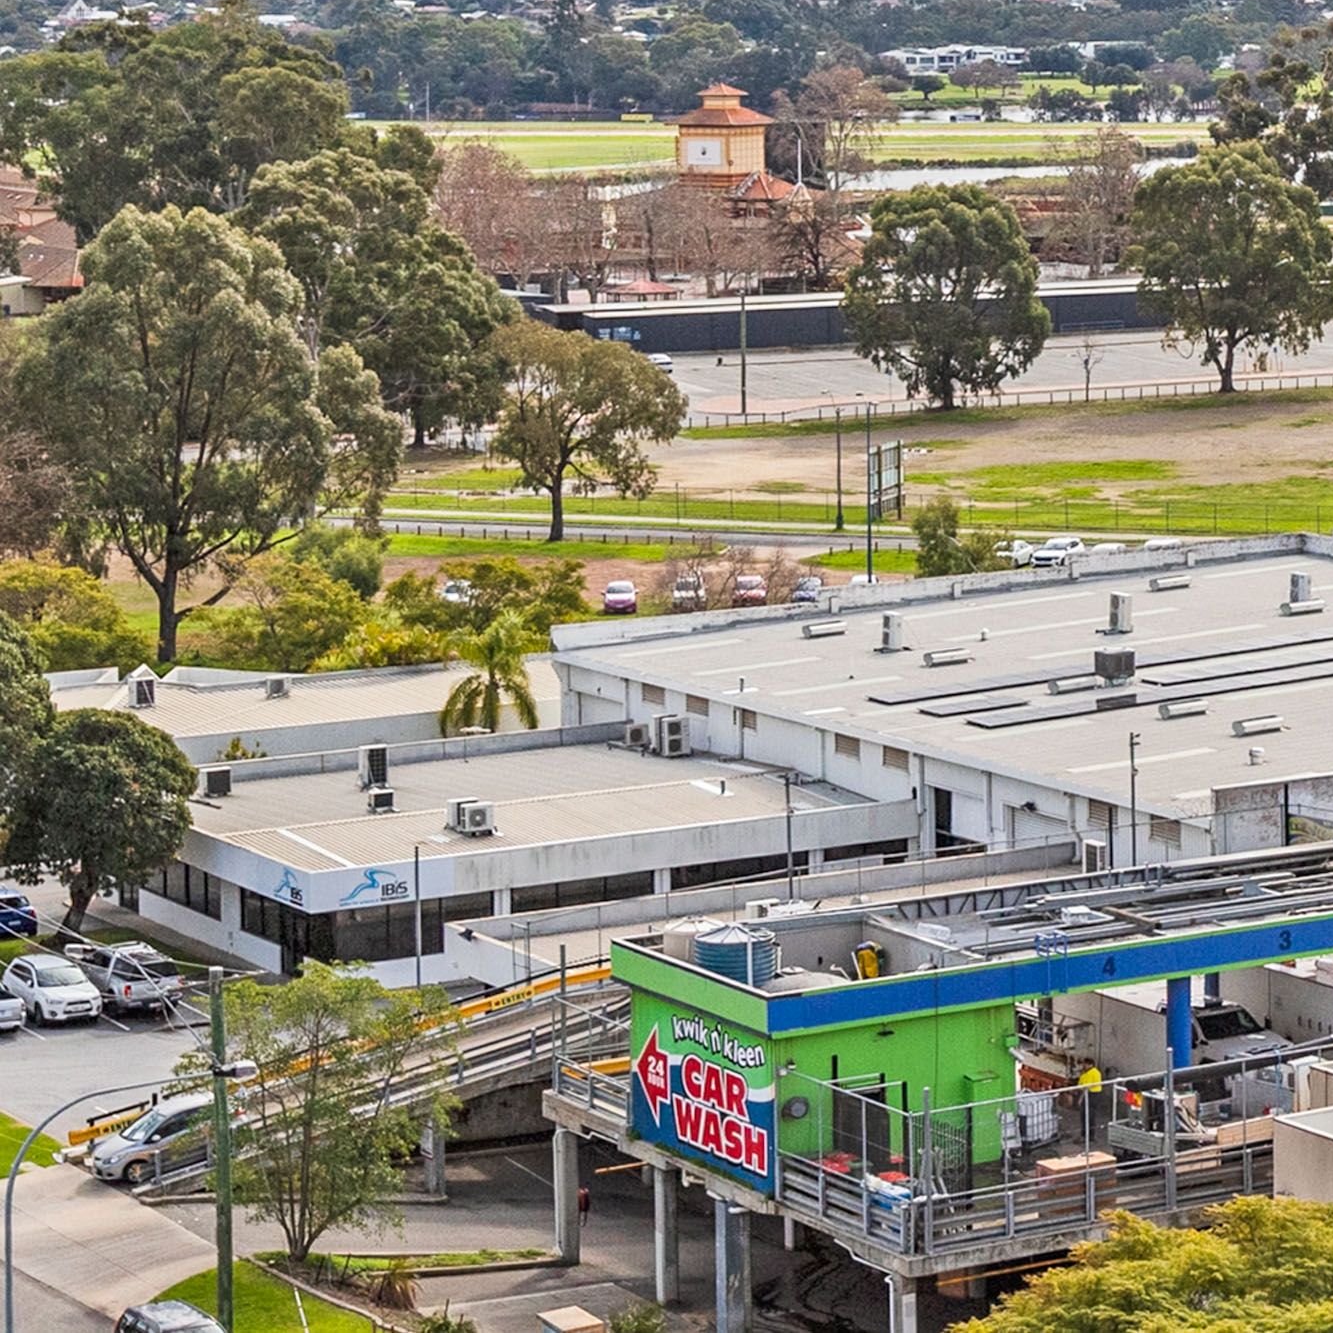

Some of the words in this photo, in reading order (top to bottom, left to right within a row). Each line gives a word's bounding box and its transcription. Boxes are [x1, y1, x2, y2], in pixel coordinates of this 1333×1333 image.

[1279, 929, 1292, 951] 3
[1102, 956, 1116, 976] 4
[501, 993, 525, 1005] ENTRY
[673, 1016, 708, 1048] kwik
[723, 1034, 765, 1066] kleen
[647, 1055, 665, 1077] 24
[682, 1054, 749, 1121] CAR
[672, 1093, 768, 1177] WASH
